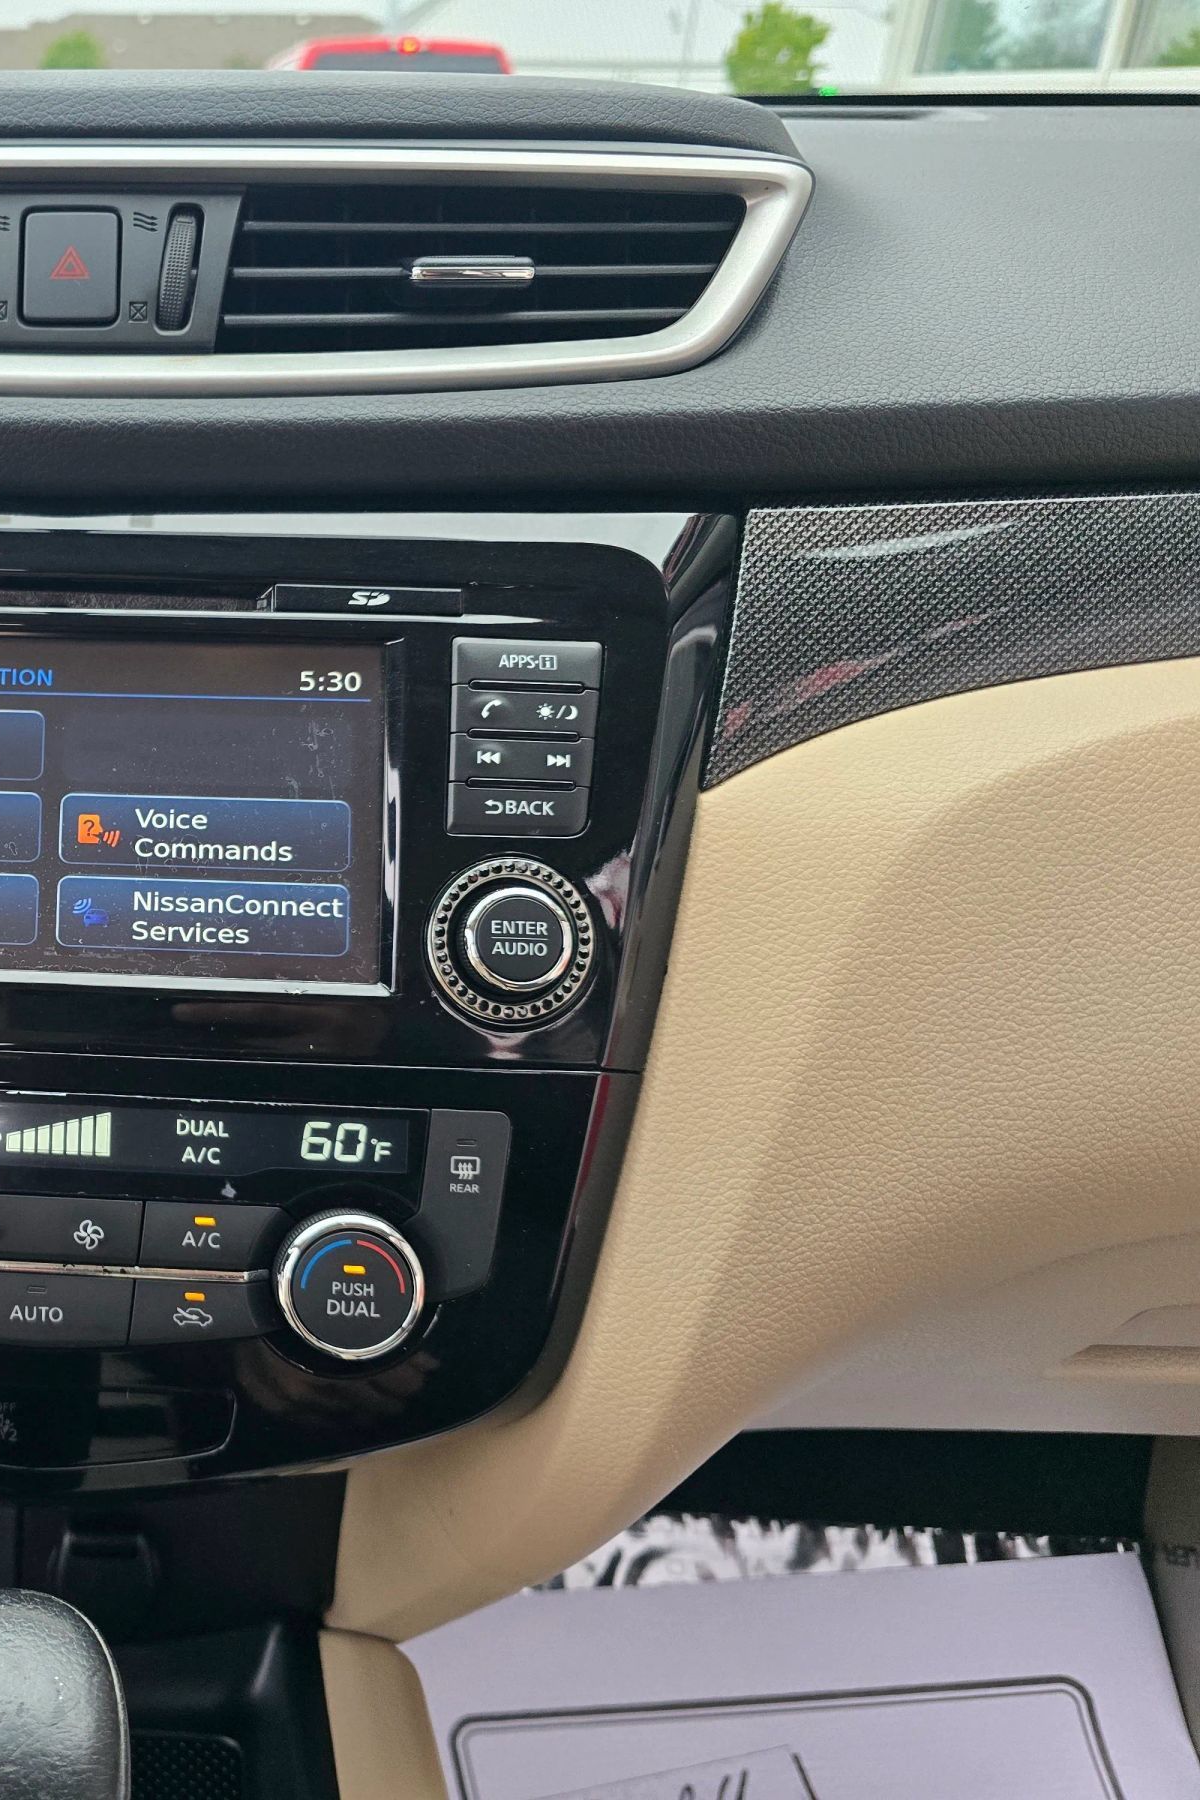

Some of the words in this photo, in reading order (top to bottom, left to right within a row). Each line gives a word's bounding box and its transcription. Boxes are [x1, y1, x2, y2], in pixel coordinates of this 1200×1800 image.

[299, 670, 362, 693] 5:30
[506, 801, 554, 816] BACK
[135, 809, 208, 830] Voice
[134, 839, 292, 862] Commands
[133, 892, 344, 919] NissanConnect
[132, 920, 249, 945] Services
[491, 920, 548, 936] ENTER
[491, 942, 548, 957] AUDIO
[176, 1119, 229, 1138] DUAL
[181, 1147, 221, 1165] A/C
[449, 1182, 480, 1195] REAR
[181, 1231, 221, 1249] A/C
[331, 1281, 374, 1297] PUSH
[9, 1305, 64, 1323] AUTO
[325, 1299, 380, 1318] DUAL
